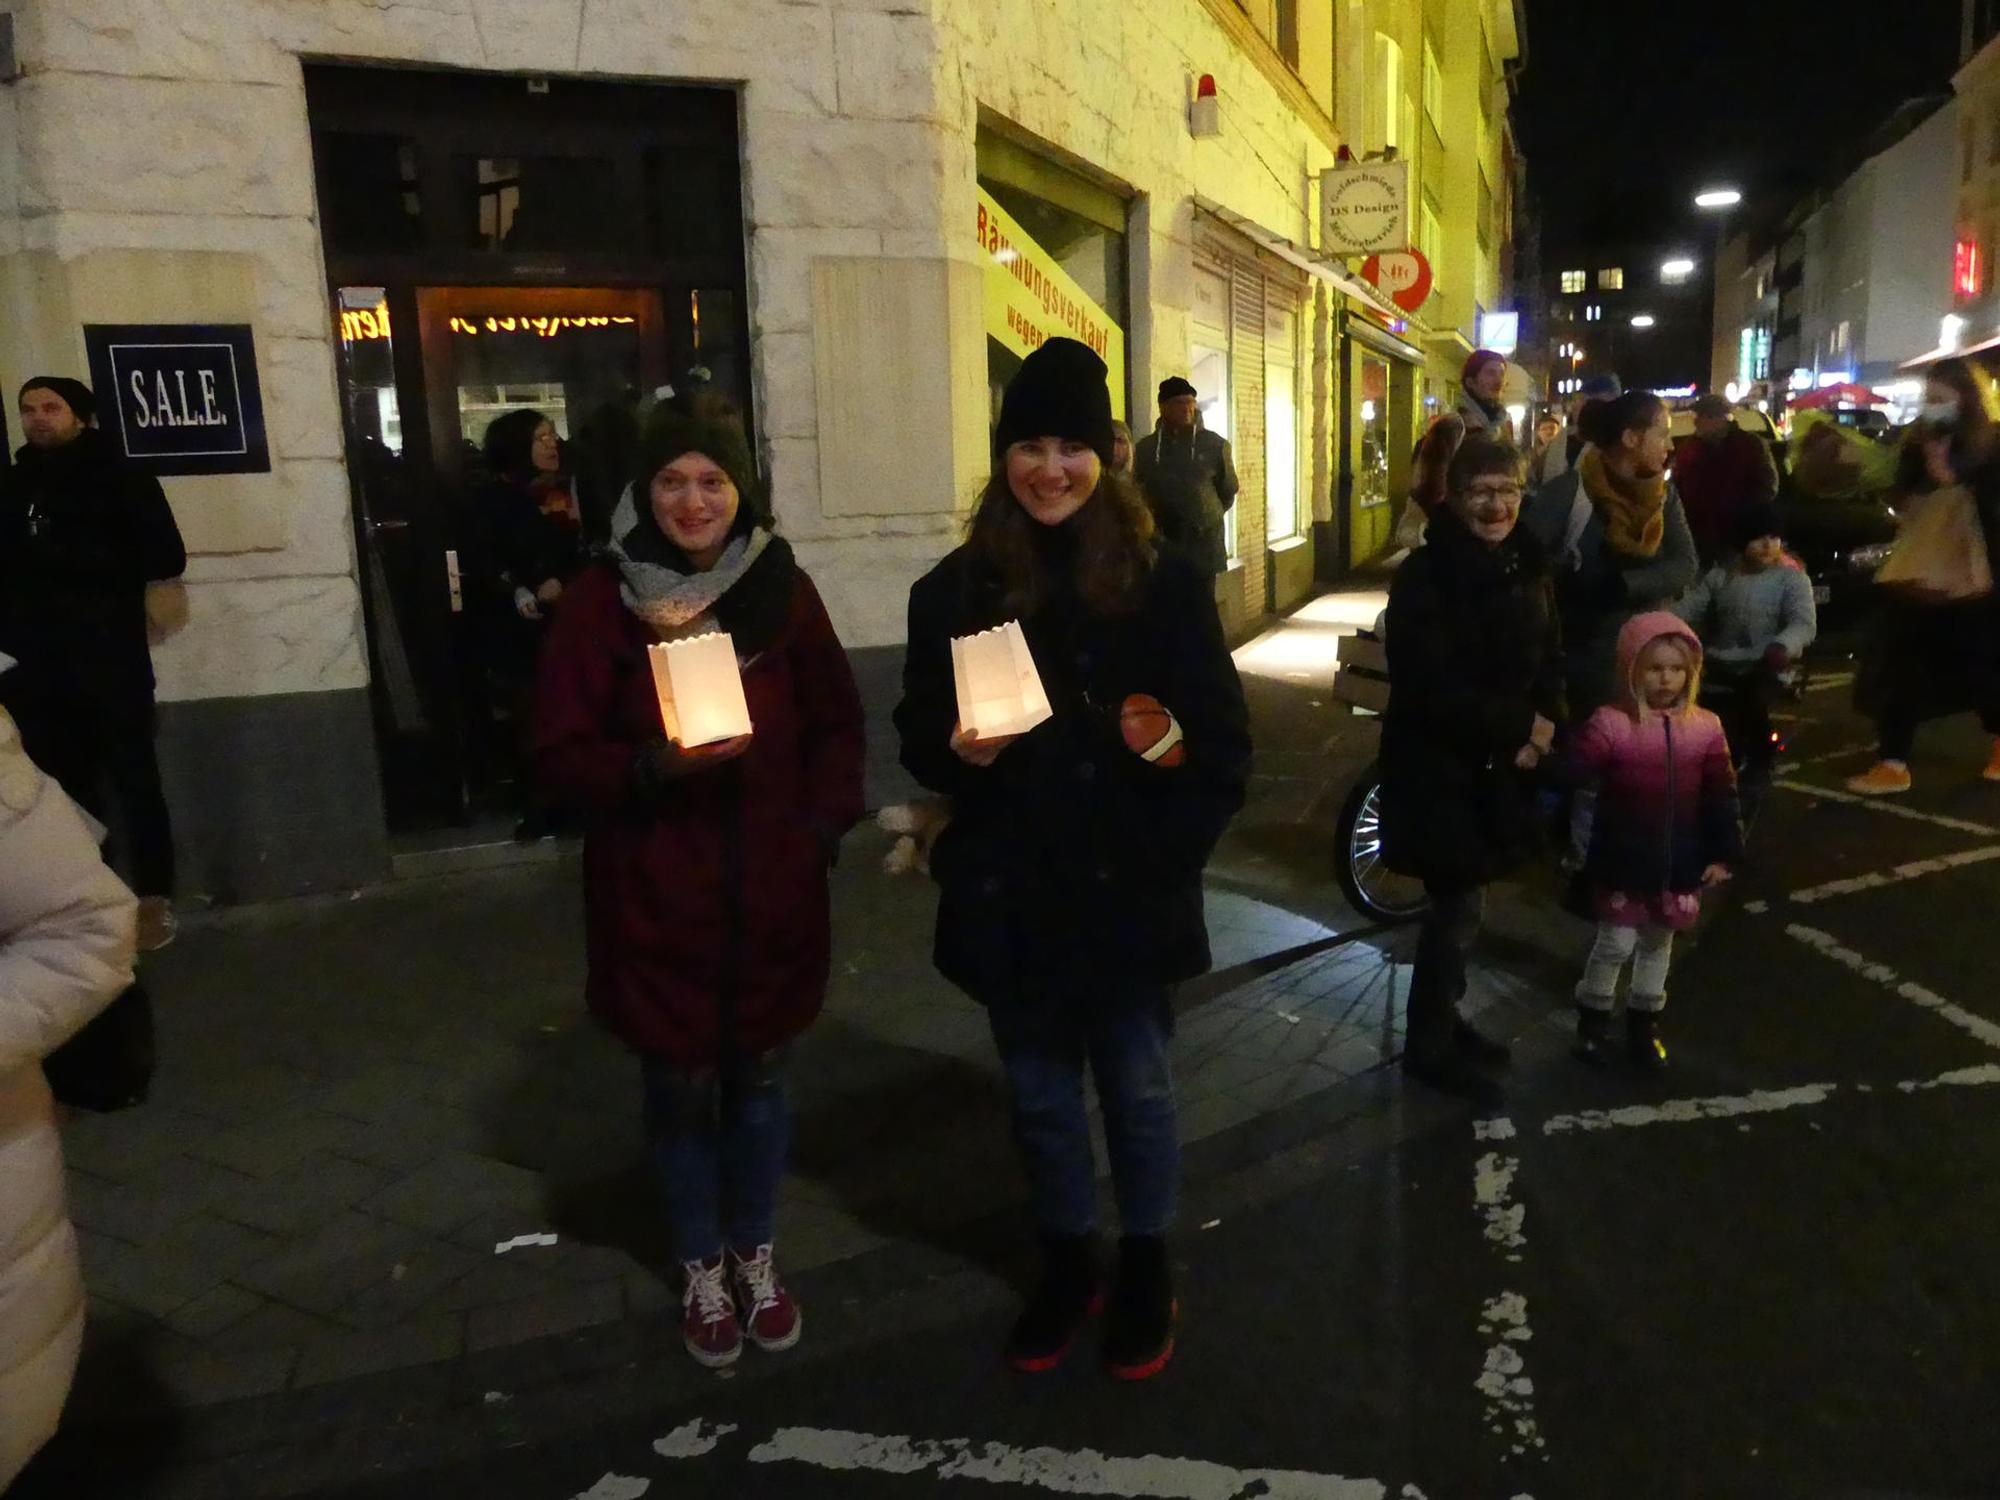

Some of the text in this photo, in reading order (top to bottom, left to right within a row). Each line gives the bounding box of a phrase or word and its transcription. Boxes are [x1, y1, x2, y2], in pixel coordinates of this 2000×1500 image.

[1331, 203, 1399, 216] DS Design
[1007, 304, 1043, 349] wegen
[131, 369, 227, 429] S.A.L.E.
